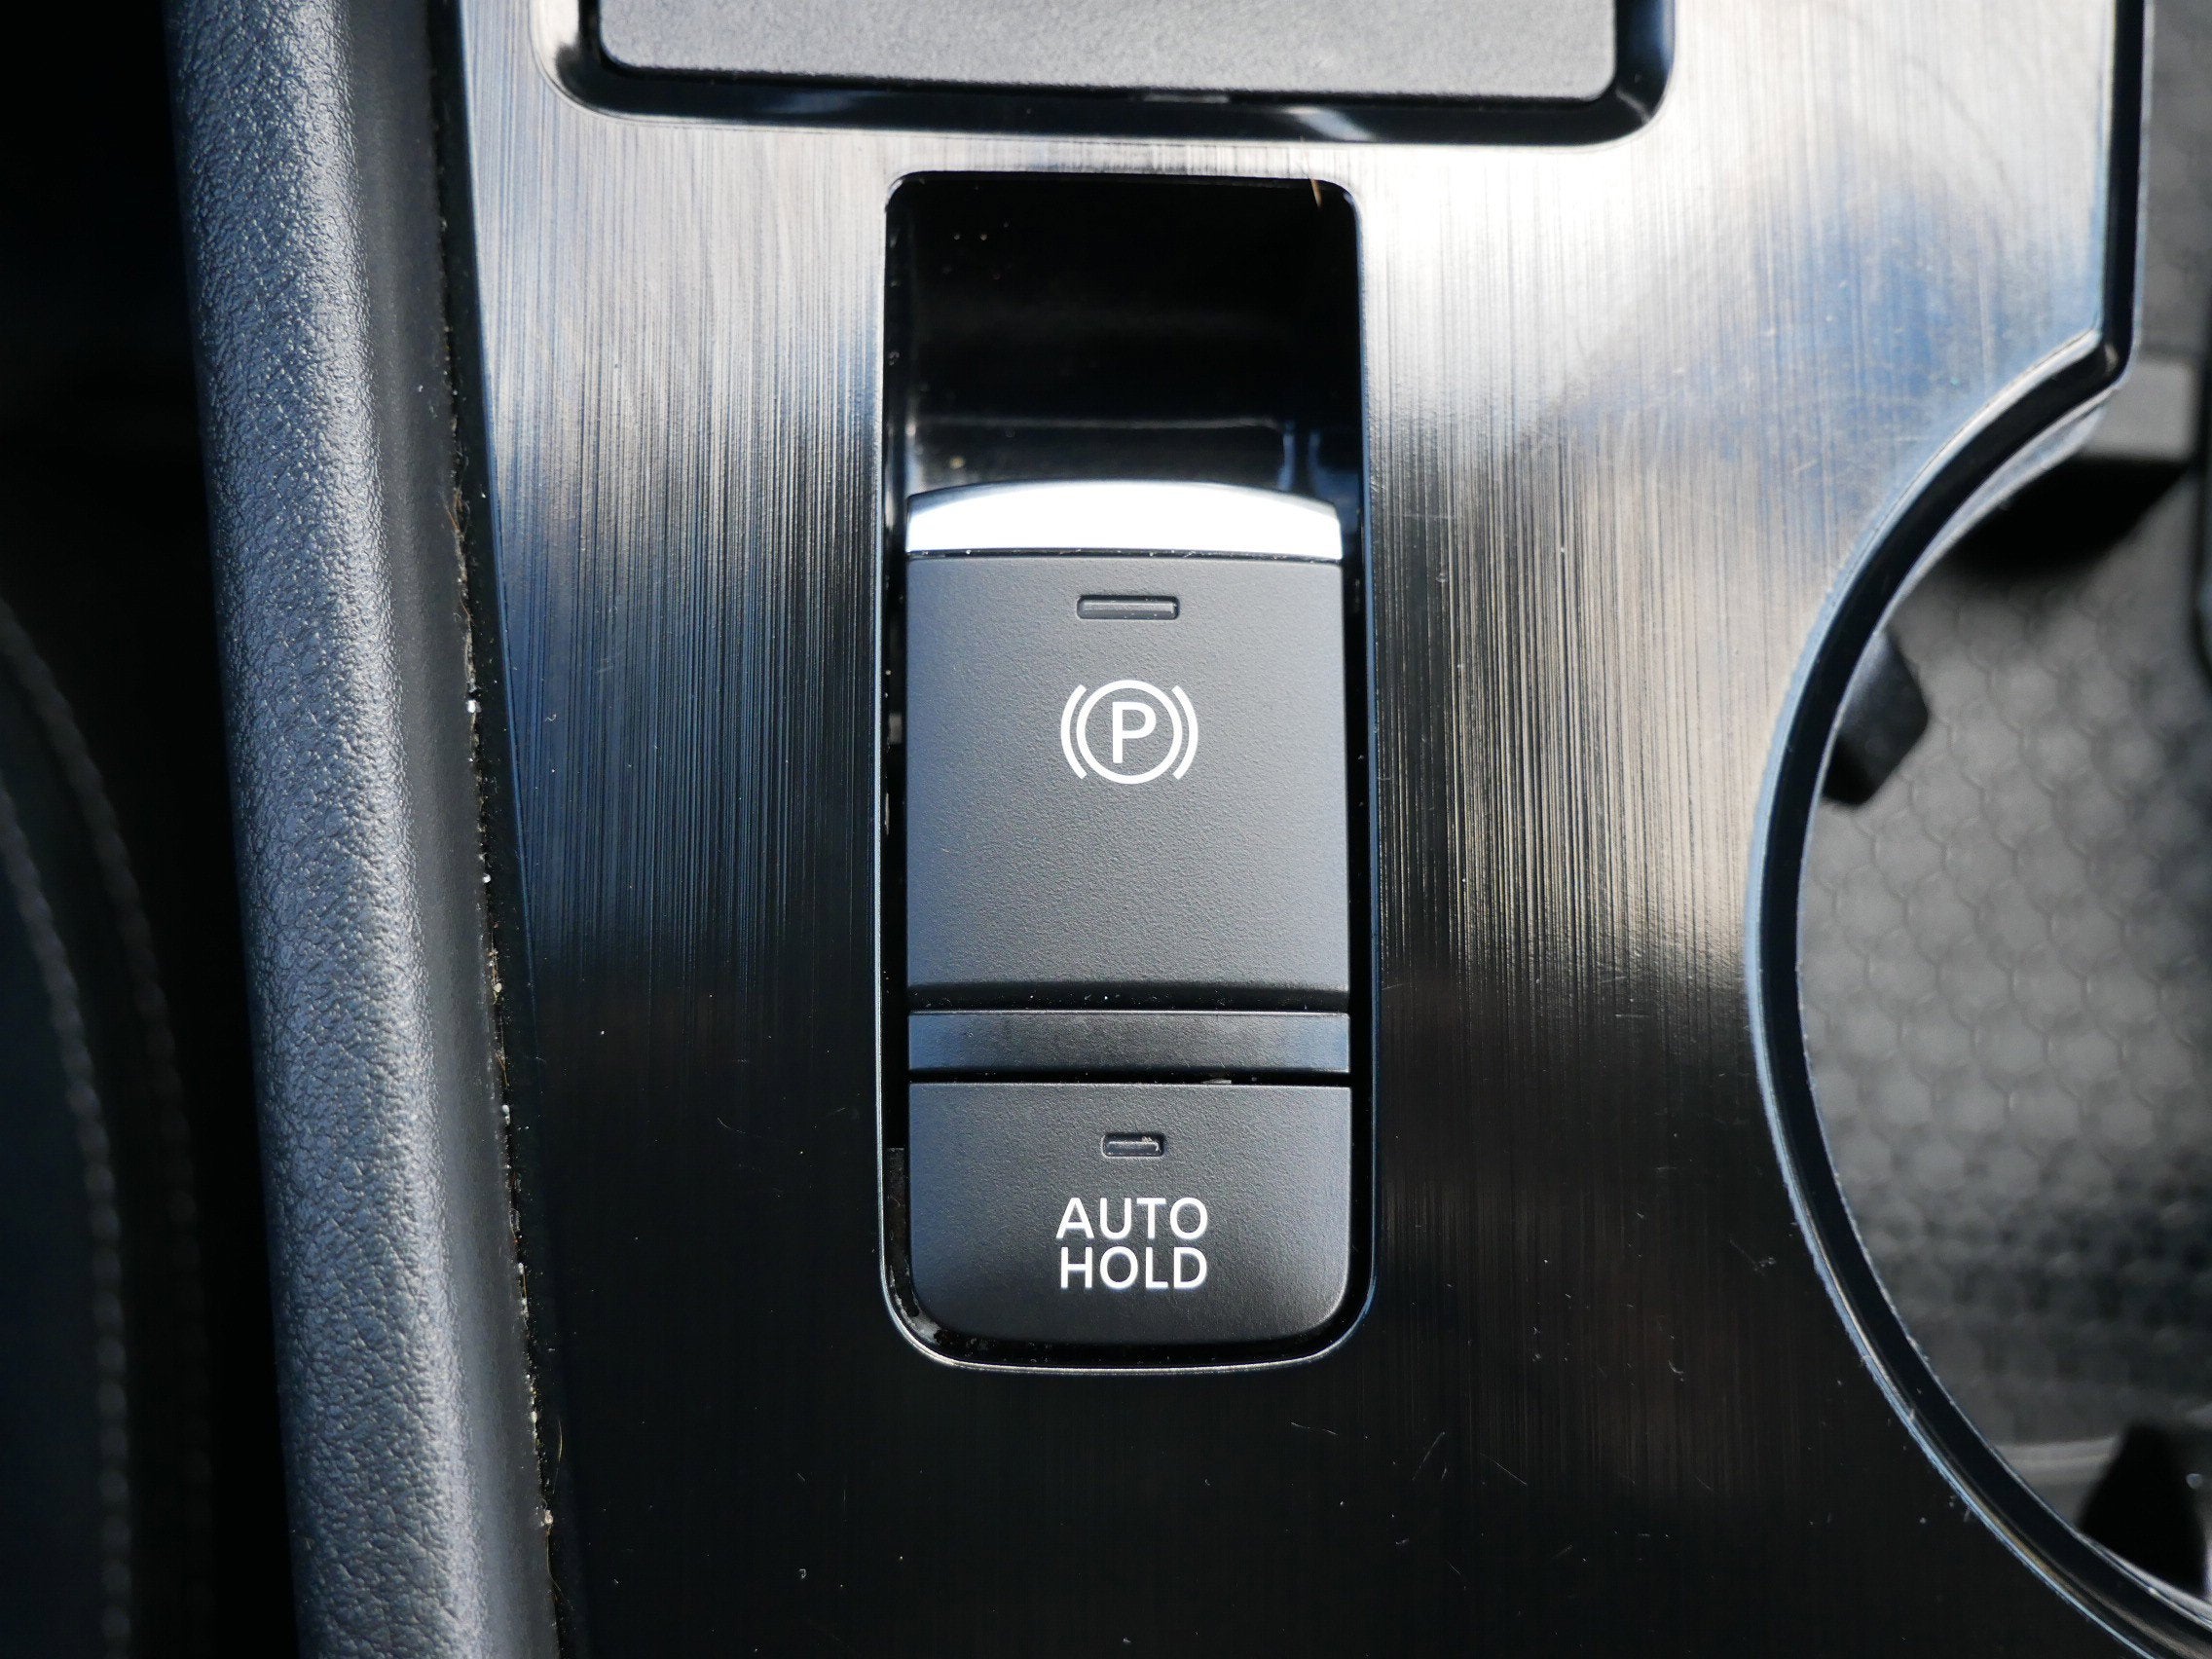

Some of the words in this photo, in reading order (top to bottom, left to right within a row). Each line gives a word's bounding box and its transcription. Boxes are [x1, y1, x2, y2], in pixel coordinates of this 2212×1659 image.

[1110, 699, 1160, 763] P
[1055, 1197, 1209, 1240] AUTO
[1060, 1245, 1208, 1290] HOLD
